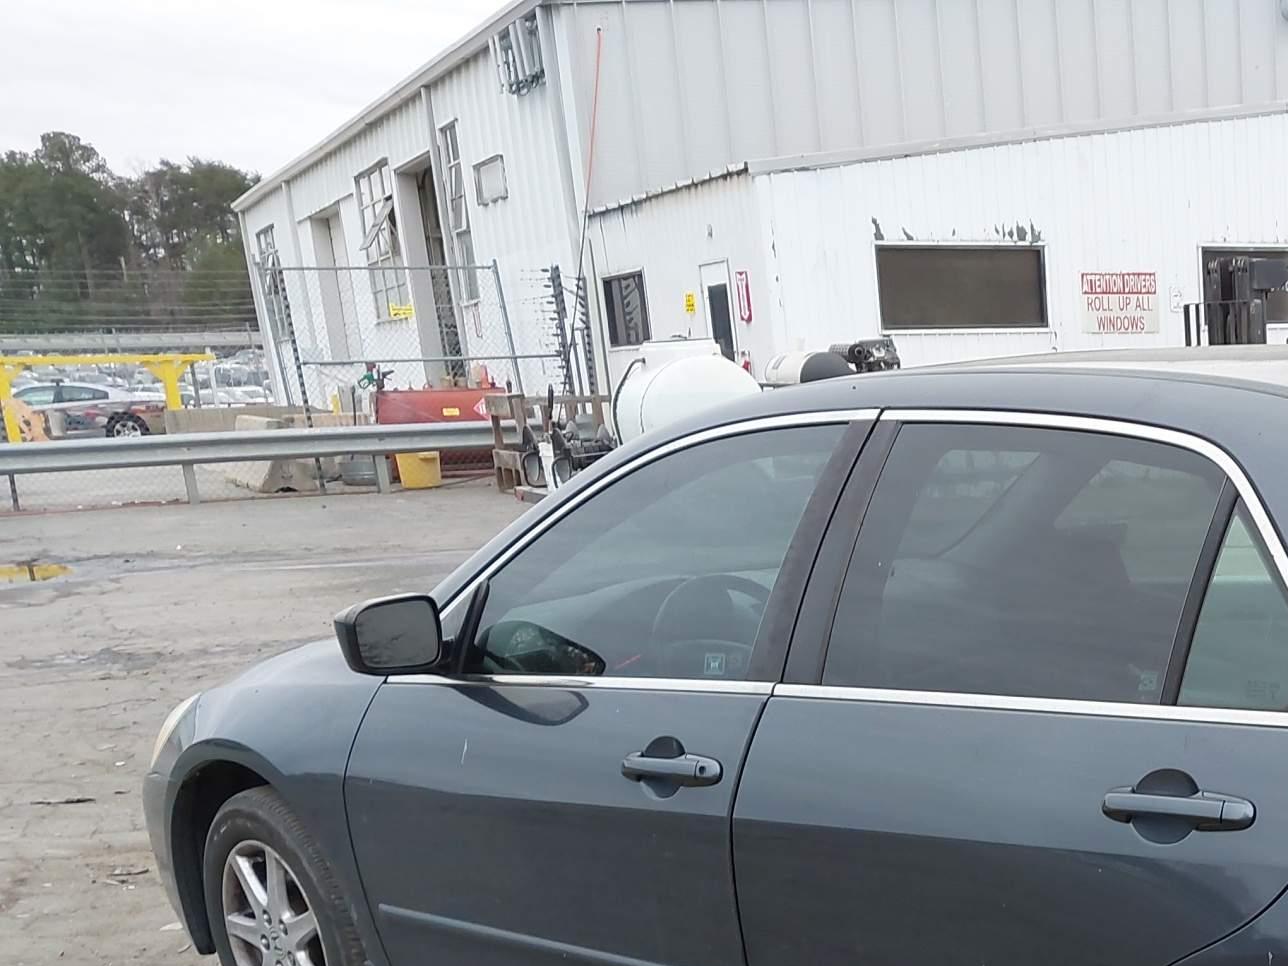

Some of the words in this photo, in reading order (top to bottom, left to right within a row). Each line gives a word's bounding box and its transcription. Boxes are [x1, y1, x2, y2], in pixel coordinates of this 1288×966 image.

[1082, 274, 1122, 293] ATTENTION
[1124, 274, 1156, 293] DRIVERS
[1087, 296, 1113, 311] ROLL
[1118, 296, 1131, 311] UP
[1135, 296, 1152, 311] ALL
[1096, 315, 1145, 331] WINDOWS
